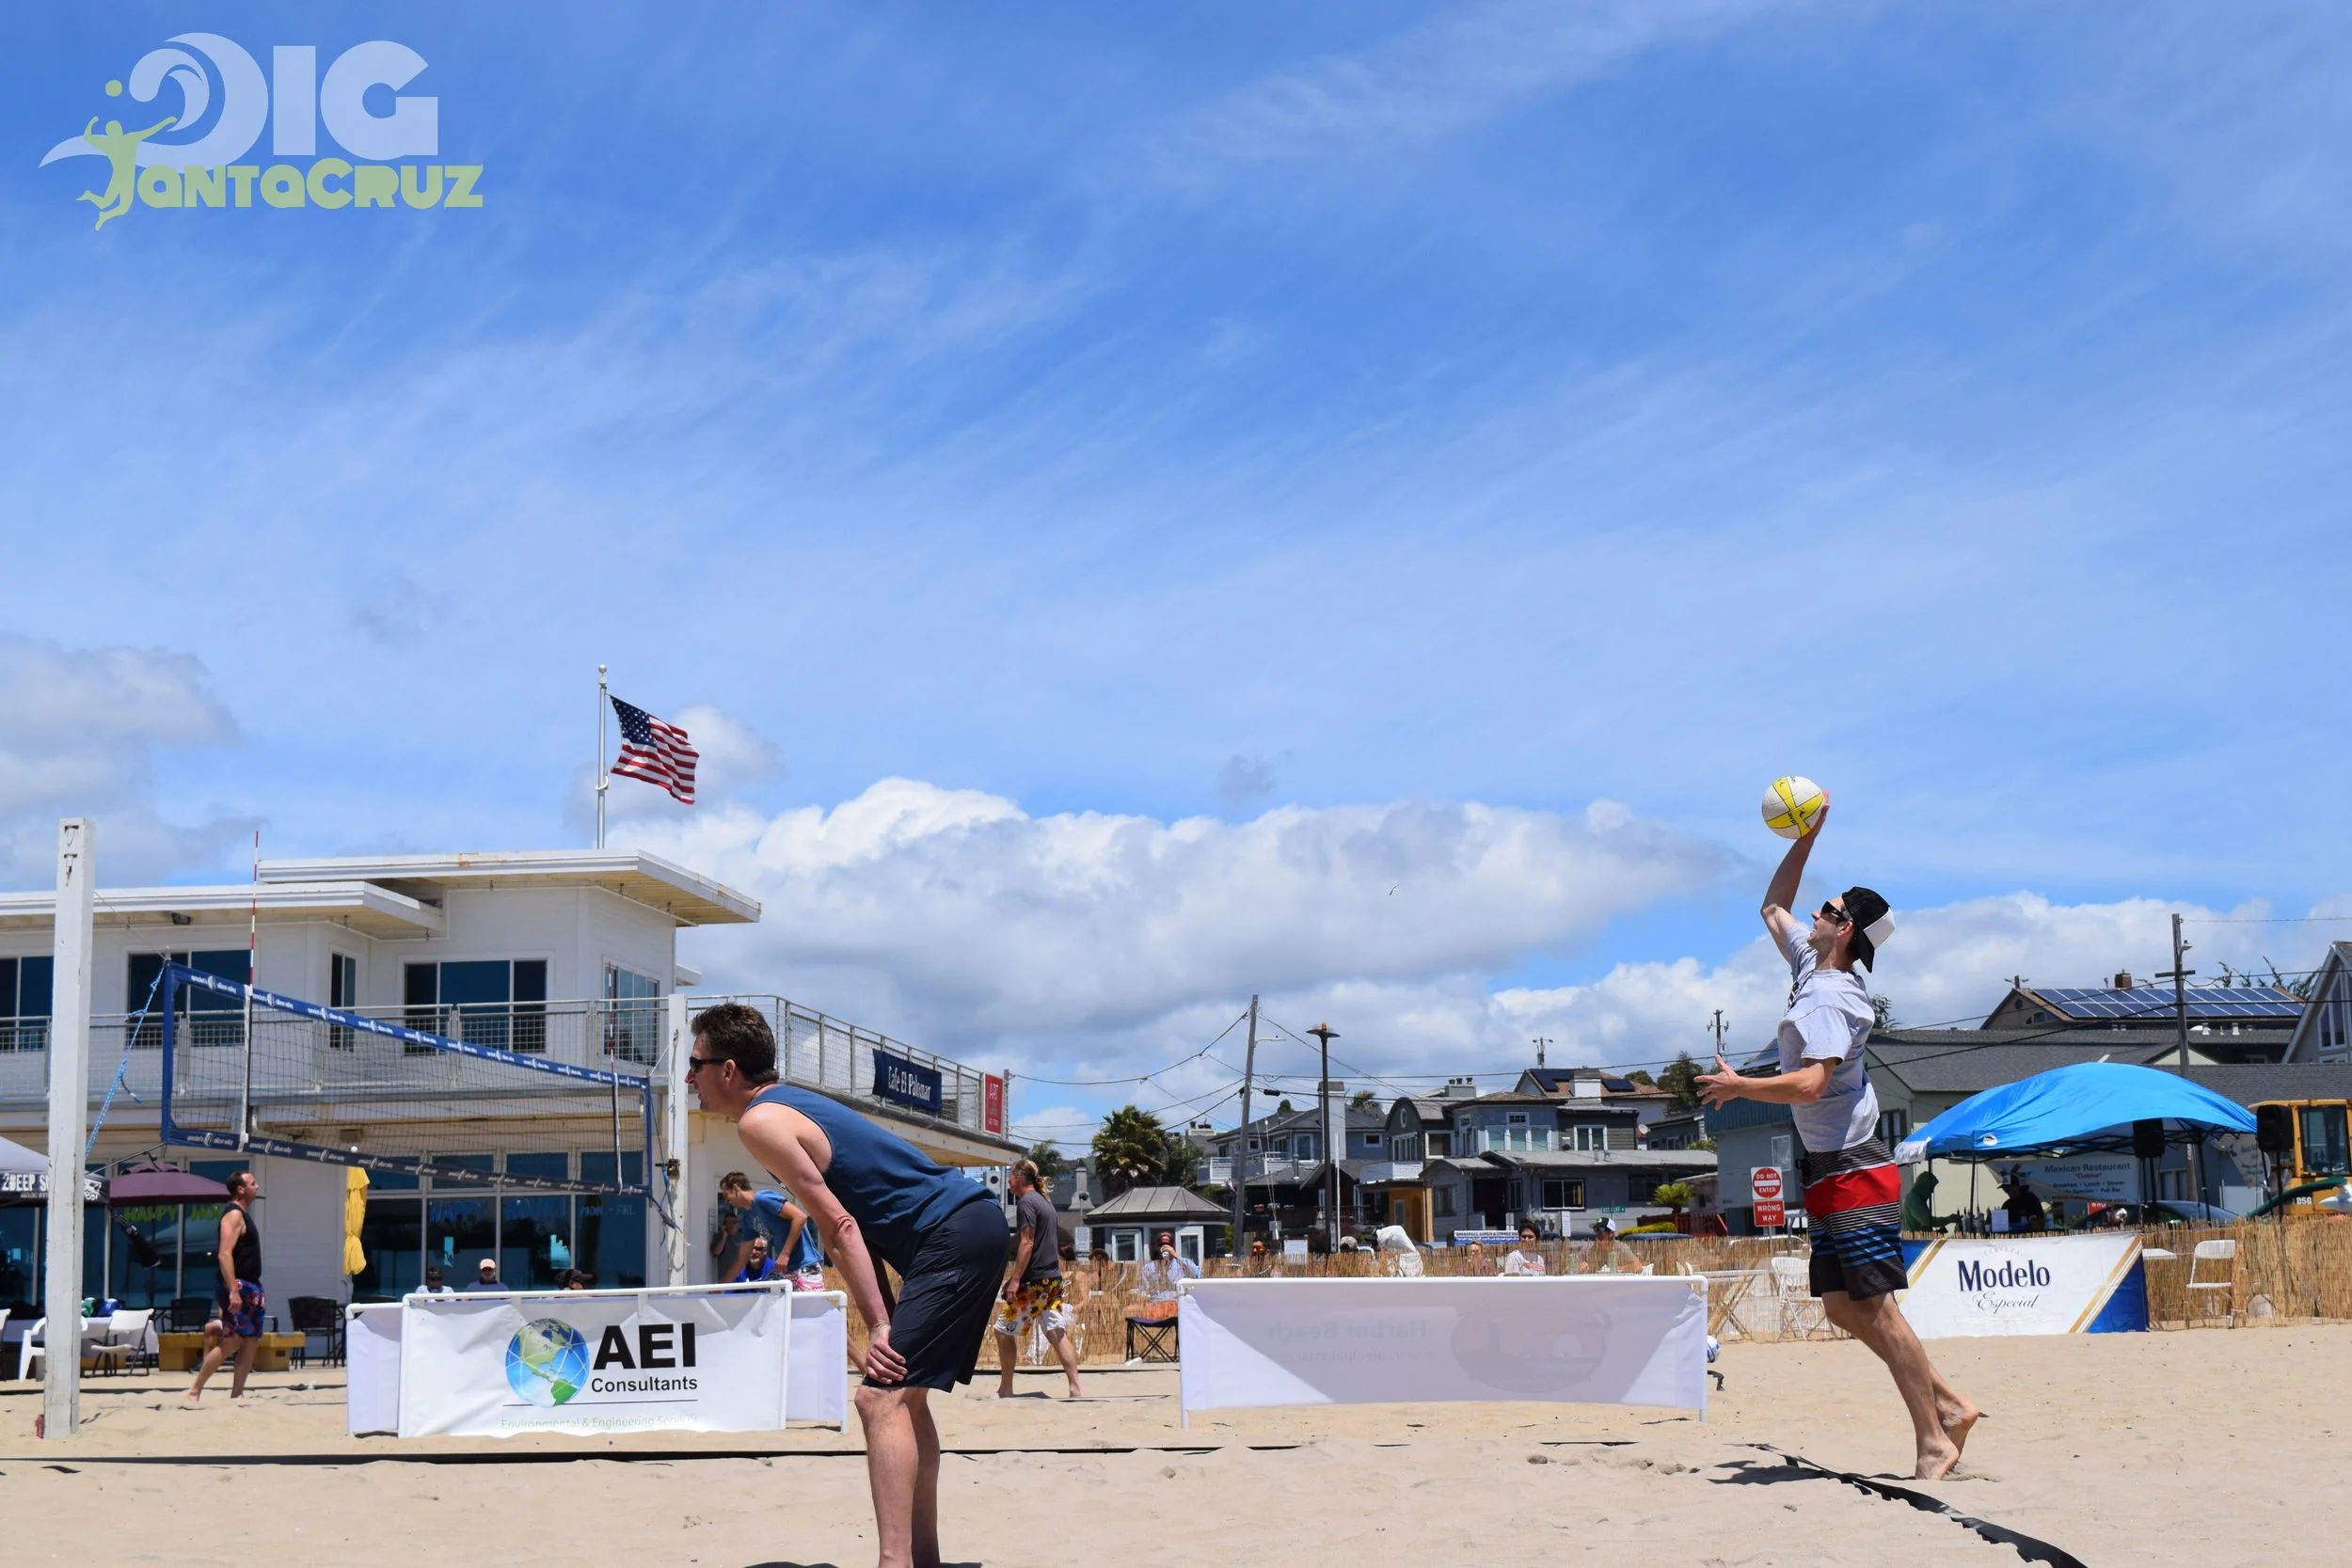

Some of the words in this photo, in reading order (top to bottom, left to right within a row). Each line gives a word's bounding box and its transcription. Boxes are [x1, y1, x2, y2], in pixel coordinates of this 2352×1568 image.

[2044, 1164, 2081, 1174] Mexican
[2083, 1163, 2130, 1172] Restaurant
[1958, 1259, 2051, 1291] Modelo
[1973, 1291, 2040, 1314] Especial
[593, 1323, 696, 1370] AEI
[591, 1375, 698, 1393] Consultants
[501, 1418, 580, 1430] Environmental
[593, 1417, 655, 1429] Engineering
